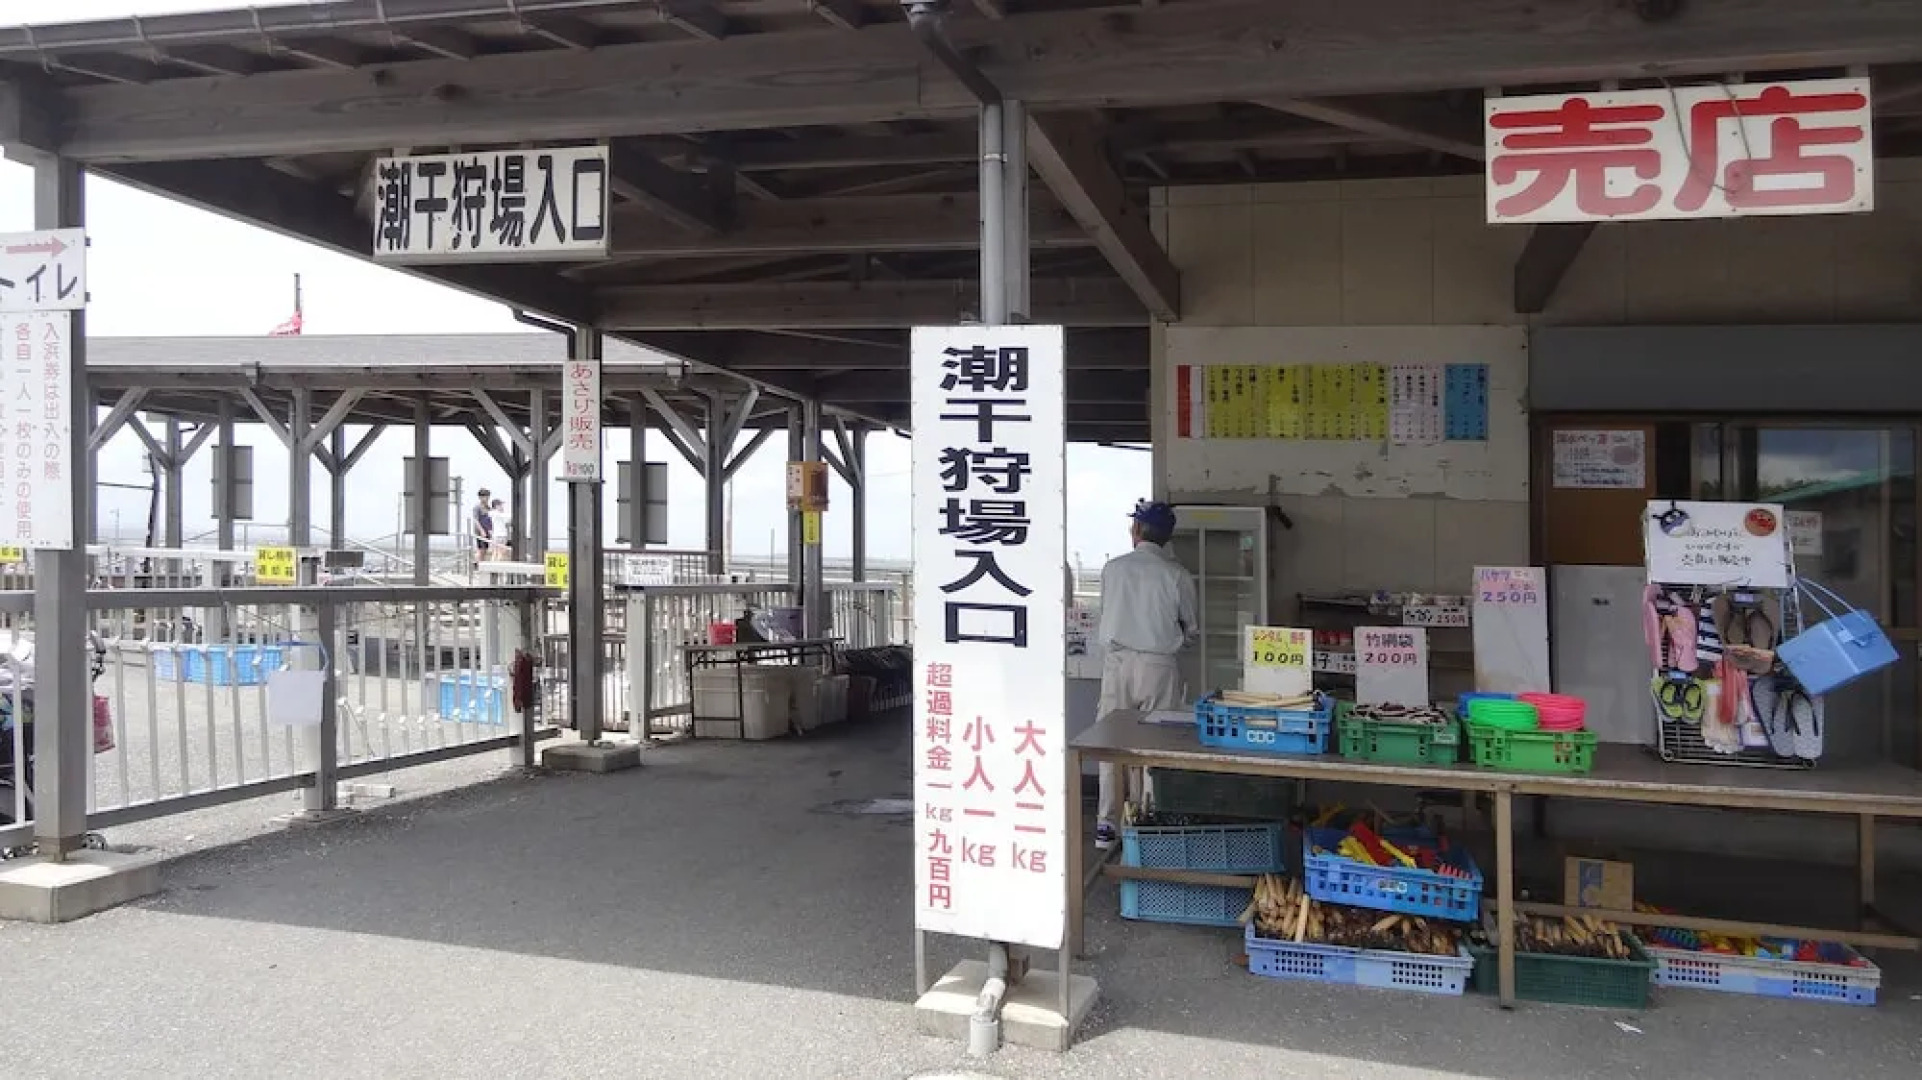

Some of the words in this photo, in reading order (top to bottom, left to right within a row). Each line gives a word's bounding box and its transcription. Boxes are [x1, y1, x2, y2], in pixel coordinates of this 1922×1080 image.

[376, 154, 606, 251] 潮干狩場入口
[1488, 85, 1867, 217] 売店
[569, 363, 594, 450] あさり販売
[938, 345, 1033, 649] 潮干狩場入口
[1483, 591, 1537, 604] 250円
[1252, 650, 1304, 666] 100円
[1364, 652, 1418, 665] 200円
[926, 661, 954, 910] 超過料金一kg九百円
[961, 714, 997, 868] 小人一kg
[1012, 720, 1047, 873] 大人二kg
